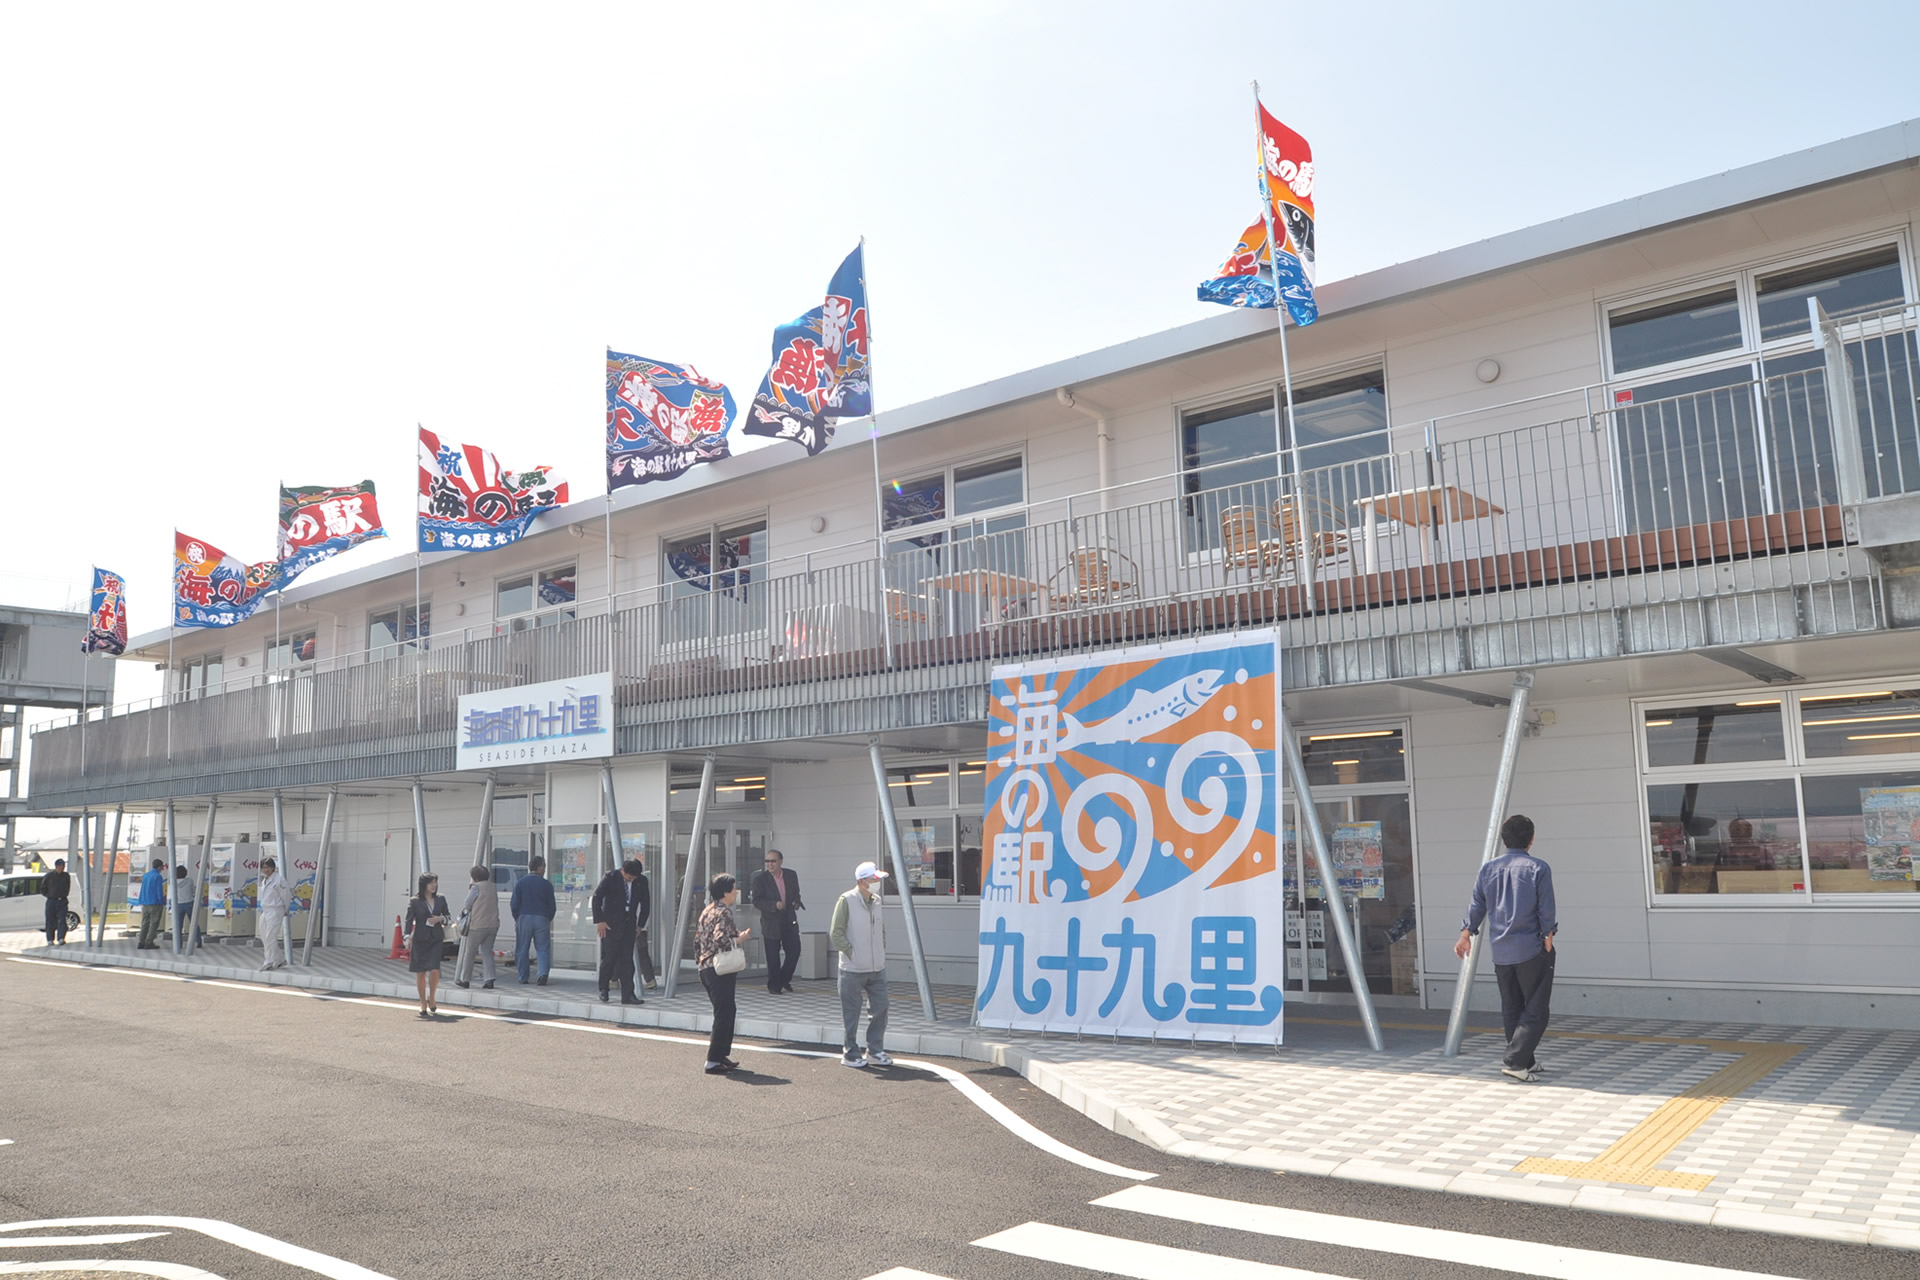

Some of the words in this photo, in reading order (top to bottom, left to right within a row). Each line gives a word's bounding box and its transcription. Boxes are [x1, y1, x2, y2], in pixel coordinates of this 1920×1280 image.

[436, 444, 462, 477] 祝
[187, 542, 204, 564] 祝
[104, 575, 120, 595] 祝
[95, 602, 115, 631] 大
[479, 747, 535, 763] SEASIDE
[544, 742, 588, 756] PLAZA
[986, 684, 1069, 905] 海の駅
[977, 915, 1284, 1026] 九十九里
